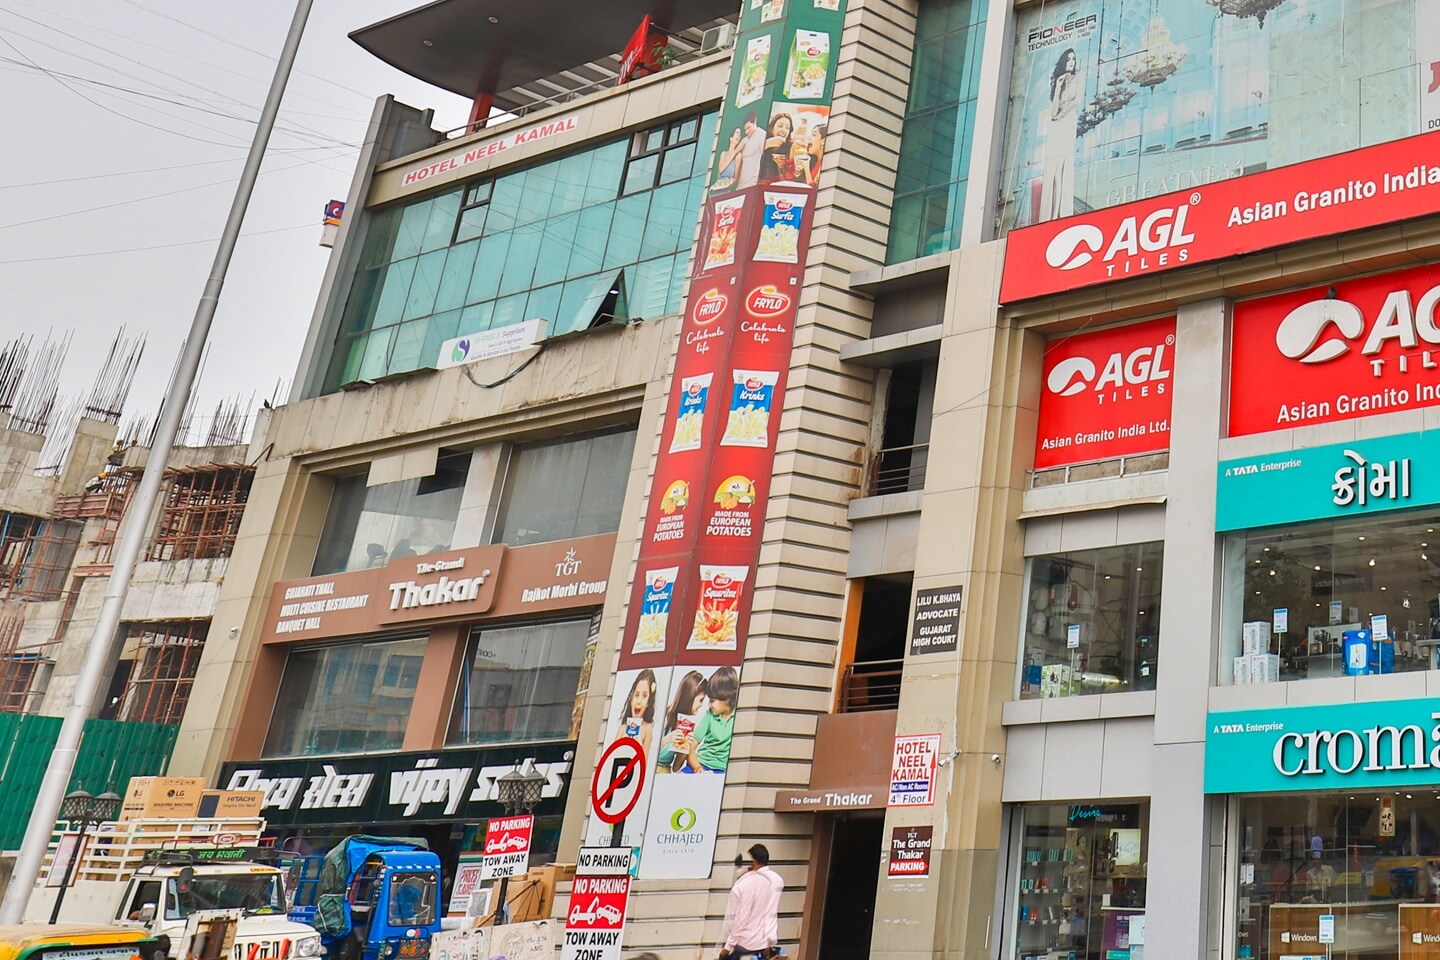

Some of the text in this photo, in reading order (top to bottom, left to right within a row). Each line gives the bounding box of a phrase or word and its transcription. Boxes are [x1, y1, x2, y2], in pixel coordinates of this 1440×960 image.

[1028, 14, 1097, 43] PIONEER
[1028, 32, 1073, 52] TECHNOLOGY
[405, 117, 577, 185] HOTEL NEEL KAMAL
[1227, 198, 1287, 228] Asian
[1293, 180, 1377, 213] Granito
[1383, 164, 1440, 194] India
[1102, 204, 1196, 262] AGL
[1106, 248, 1188, 276] TILES
[700, 299, 721, 316] FRYLO
[753, 297, 782, 311] FRYLO
[740, 321, 786, 333] Celebrate
[686, 328, 725, 344] Celebrate
[754, 330, 770, 343] life
[696, 342, 710, 353] life
[1094, 344, 1170, 391] AGL
[740, 390, 765, 401] Krinks
[1097, 383, 1165, 405] TILES
[1277, 395, 1331, 424] Asian
[1336, 387, 1410, 415] Granito
[1041, 419, 1170, 450] Asian Granito India Ltd.
[1233, 458, 1302, 476] TATA Enterprise
[1331, 449, 1412, 506] ક્રોમા
[714, 509, 749, 518] MADE FROM
[656, 520, 684, 533] EUROPEAN
[710, 516, 751, 527] EUROPEAN
[653, 529, 684, 542] POTATOES
[706, 526, 752, 537] POTATOES
[555, 560, 582, 577] TGT
[389, 575, 485, 610] Thakar
[521, 580, 606, 603] Rajkot Morbi Group
[325, 594, 370, 611] RESTAURANT
[916, 593, 961, 607] LILU K.BHAYA
[916, 608, 959, 620] ADVOCATE
[919, 624, 952, 635] GUJARAT
[912, 634, 956, 647] HIGH COURT
[1220, 721, 1284, 734] TATA Enterprise
[896, 741, 931, 755] HOTEL
[899, 755, 926, 768] NEEL
[892, 768, 930, 781] KAMAL
[790, 792, 873, 807] The Grand Thakar
[902, 794, 926, 803] Floor
[489, 817, 531, 832] NO PARKING
[657, 833, 704, 846] CHHAJED
[893, 839, 931, 848] The Grand
[484, 853, 526, 866] TOW AWAY
[897, 850, 924, 859] Thakar
[579, 855, 629, 868] NO PARKING
[890, 862, 925, 871] PARKING
[492, 867, 514, 877] ZONE
[574, 878, 628, 894] NO PARKING
[566, 932, 619, 945] TOW AWAY
[1291, 933, 1317, 943] Windows
[575, 950, 603, 960] ZONE
